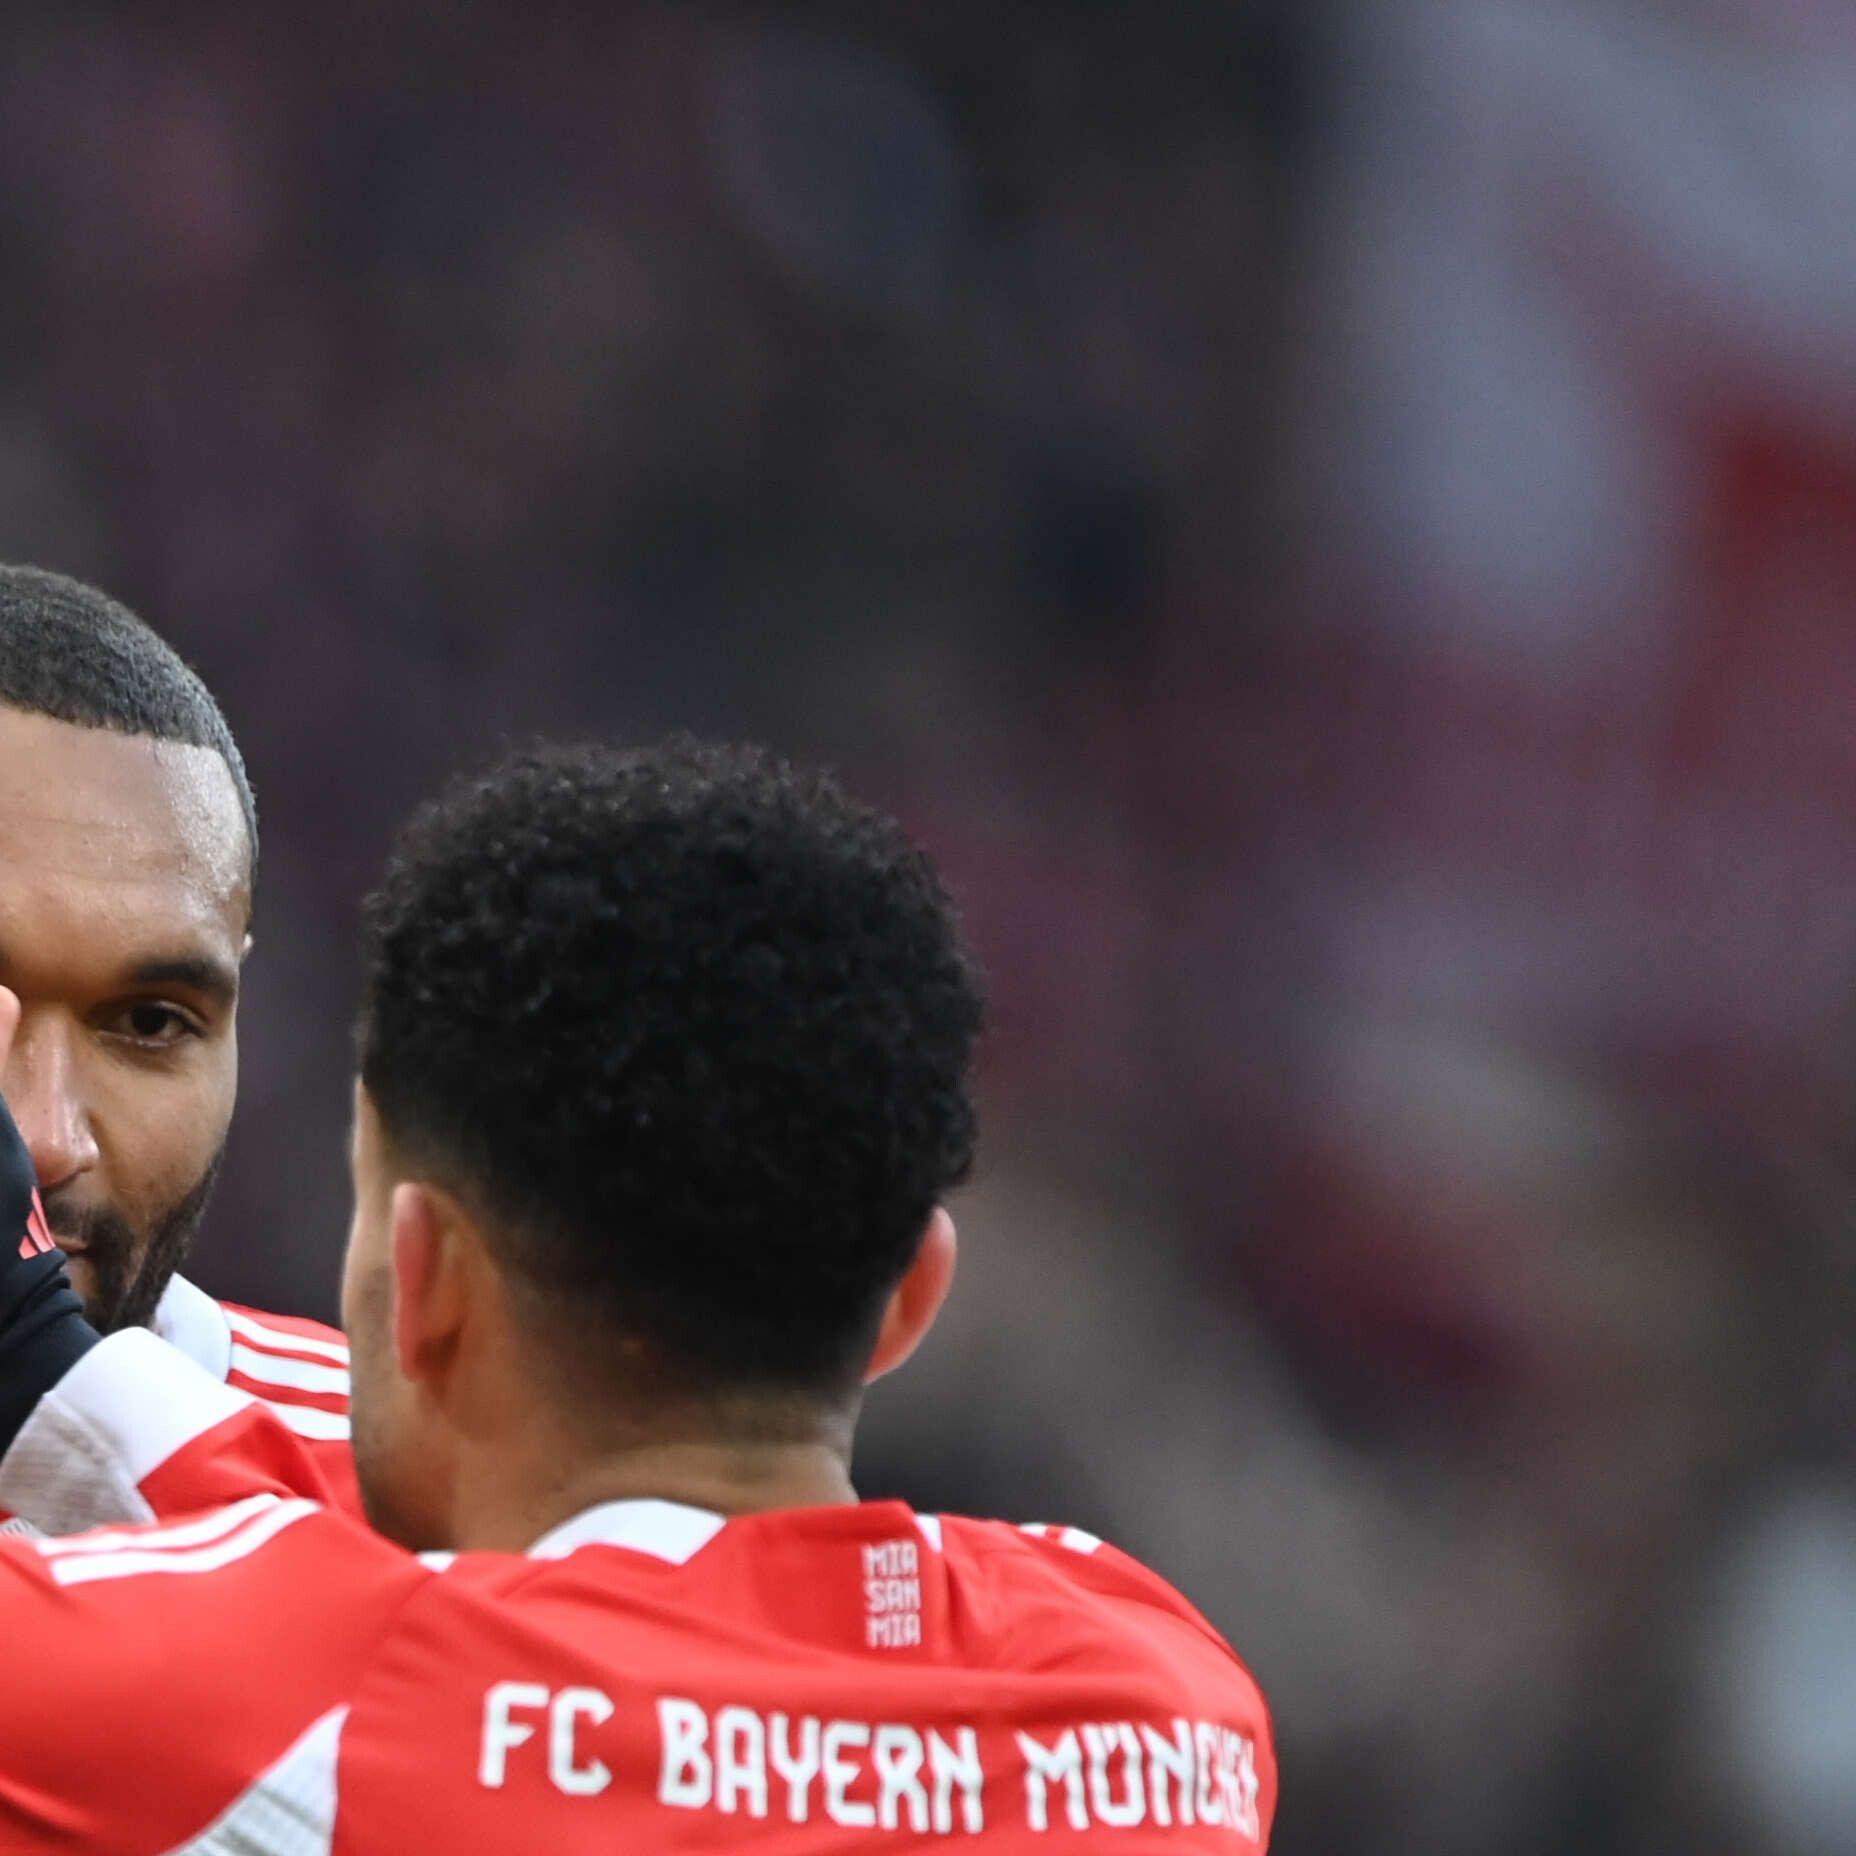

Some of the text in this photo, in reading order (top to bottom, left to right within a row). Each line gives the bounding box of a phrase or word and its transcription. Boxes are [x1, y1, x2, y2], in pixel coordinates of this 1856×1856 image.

[861, 1540, 918, 1576] MIA
[864, 1579, 920, 1612] SAN
[866, 1613, 922, 1649] MIA
[478, 1681, 614, 1796] FC
[656, 1697, 984, 1834] BAYERN
